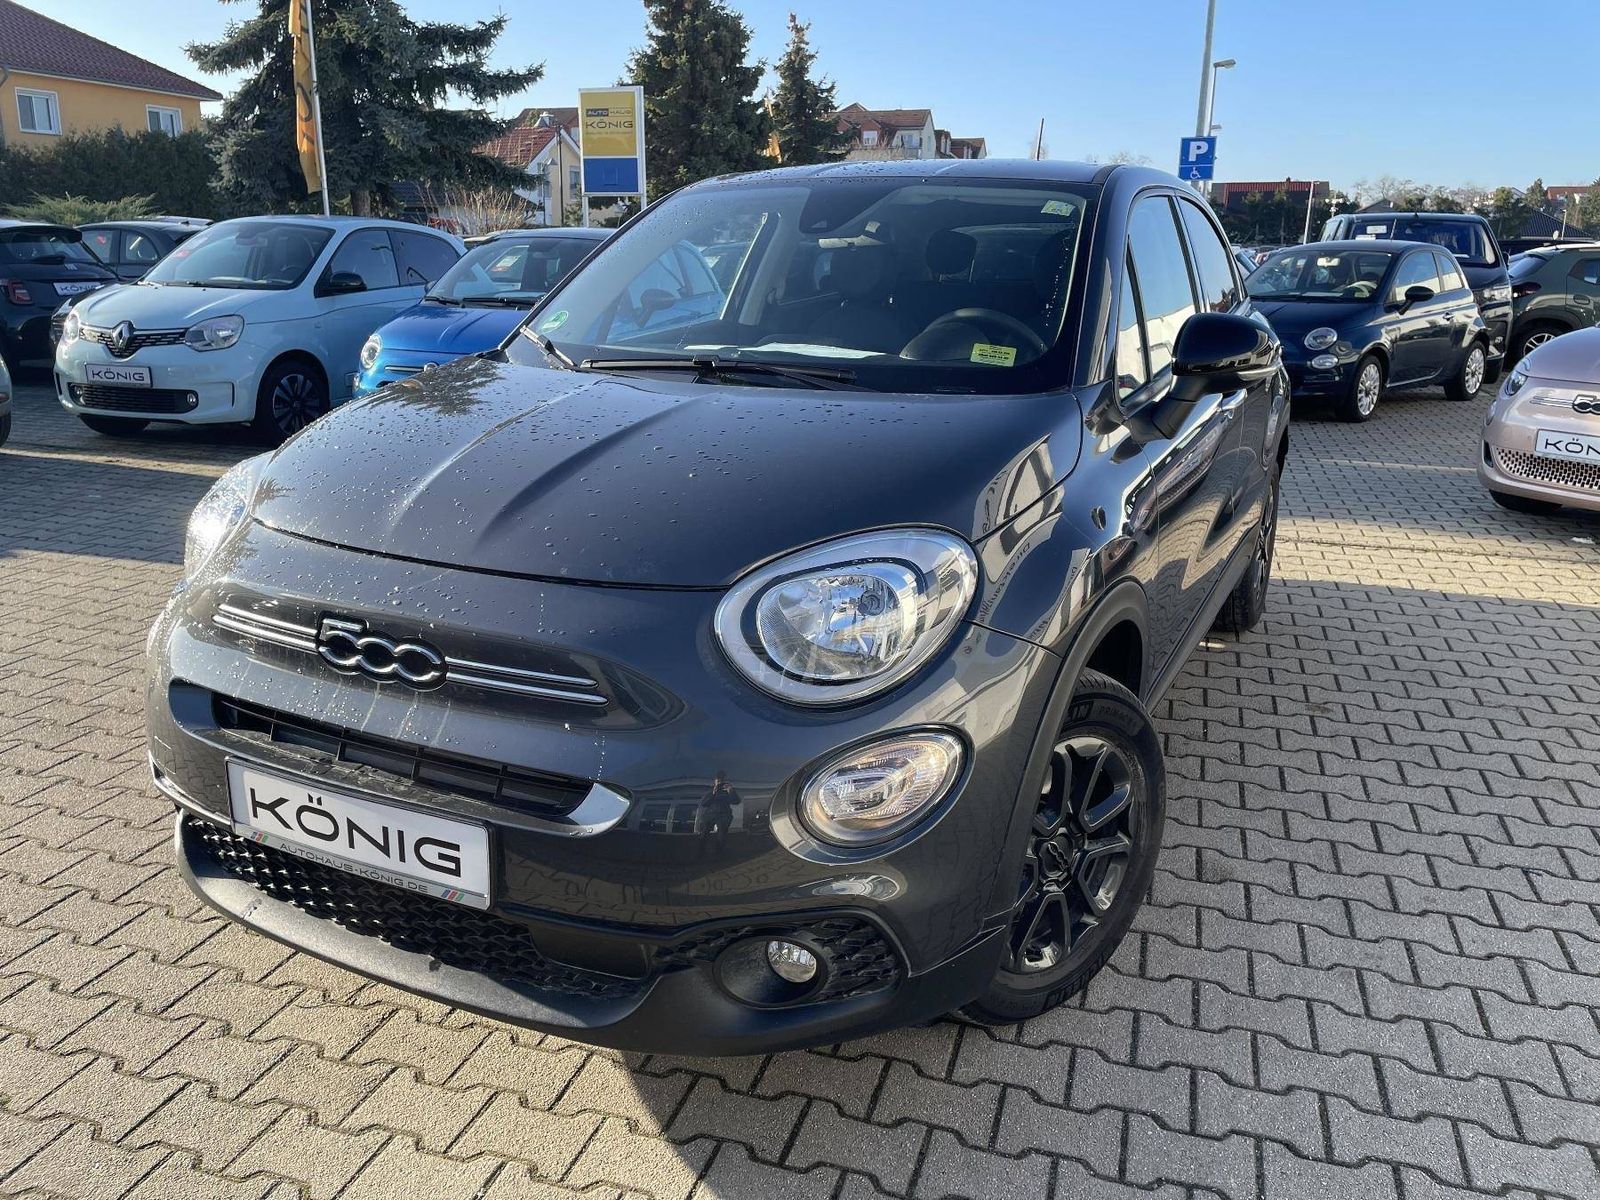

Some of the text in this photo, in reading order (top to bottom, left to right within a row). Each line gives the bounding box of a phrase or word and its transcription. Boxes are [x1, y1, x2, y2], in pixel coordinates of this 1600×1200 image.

[586, 118, 633, 129] KÖNIG
[1188, 140, 1209, 162] P
[91, 367, 145, 382] KÖNIG
[317, 614, 445, 687] 500
[249, 787, 462, 878] KÖNIG
